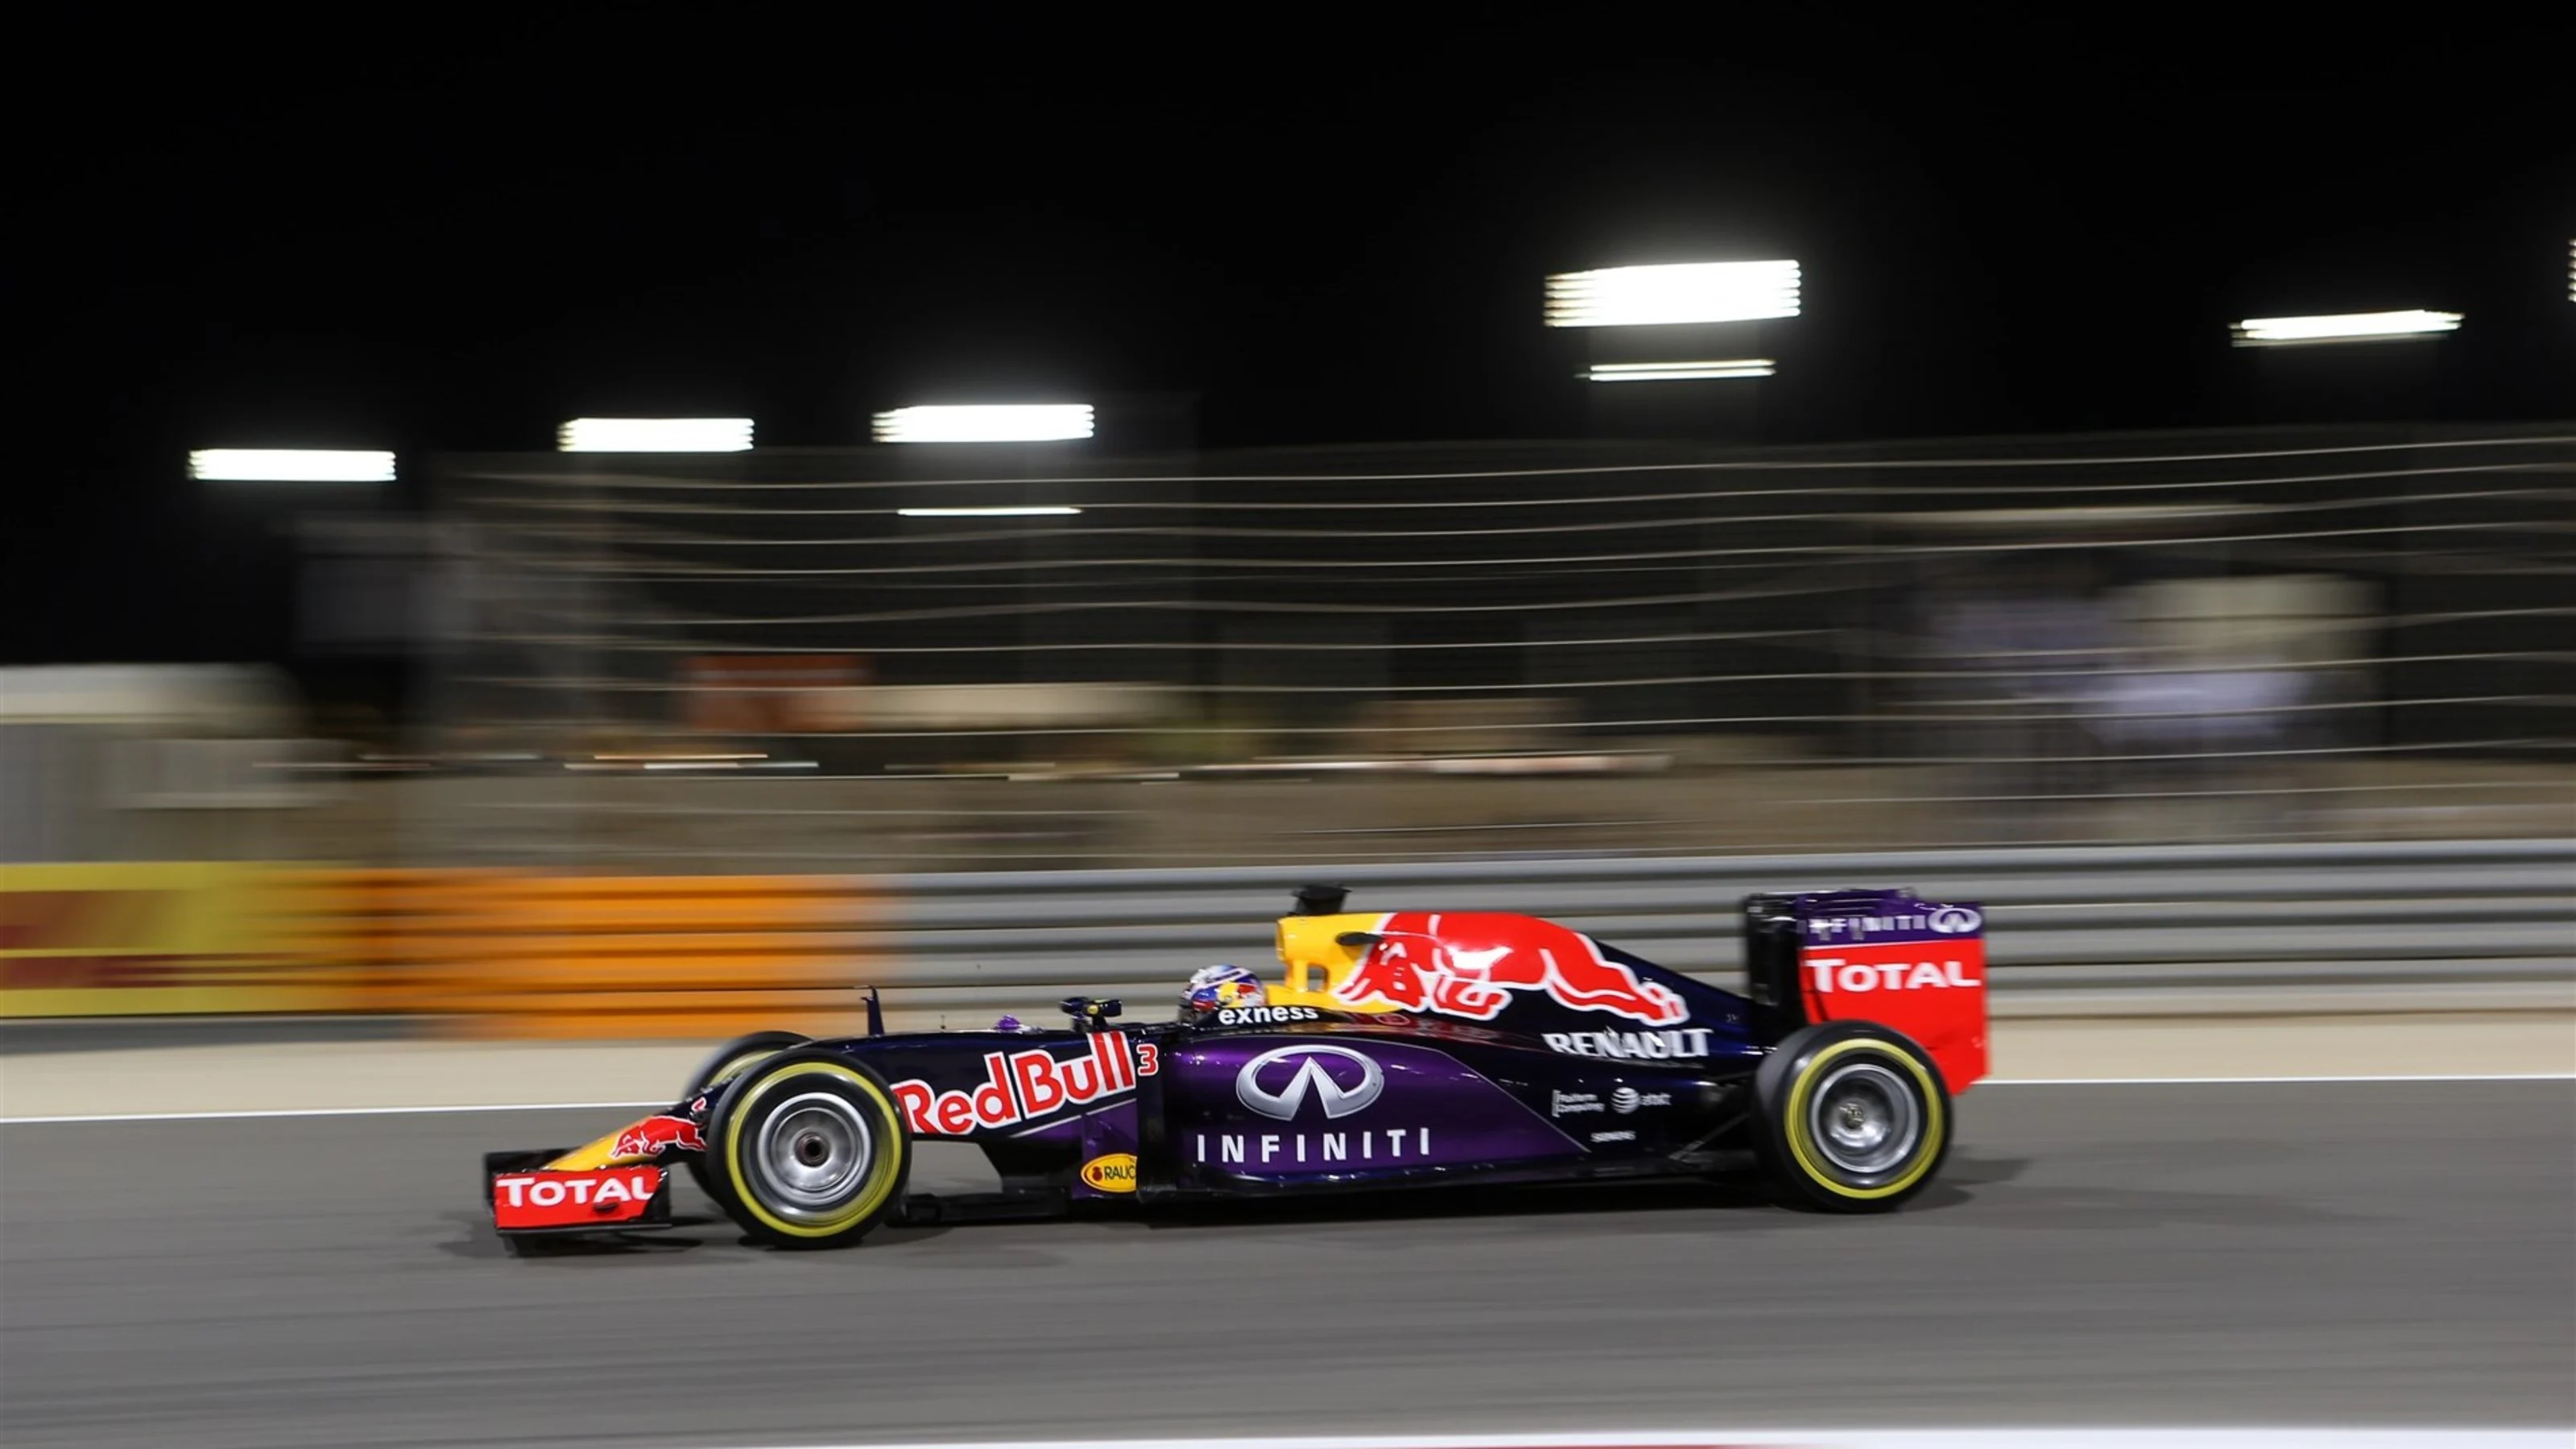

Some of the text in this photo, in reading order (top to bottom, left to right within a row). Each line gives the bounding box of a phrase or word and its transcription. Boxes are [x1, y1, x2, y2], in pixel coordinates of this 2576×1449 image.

[1804, 959, 1981, 993] TOTAL
[1218, 1006, 1318, 1025] exness
[1136, 1043, 1158, 1076] 3
[1540, 1028, 1713, 1059] RENAULT
[1197, 1128, 1429, 1162] INFINITI
[496, 1176, 654, 1208] TOTAL
